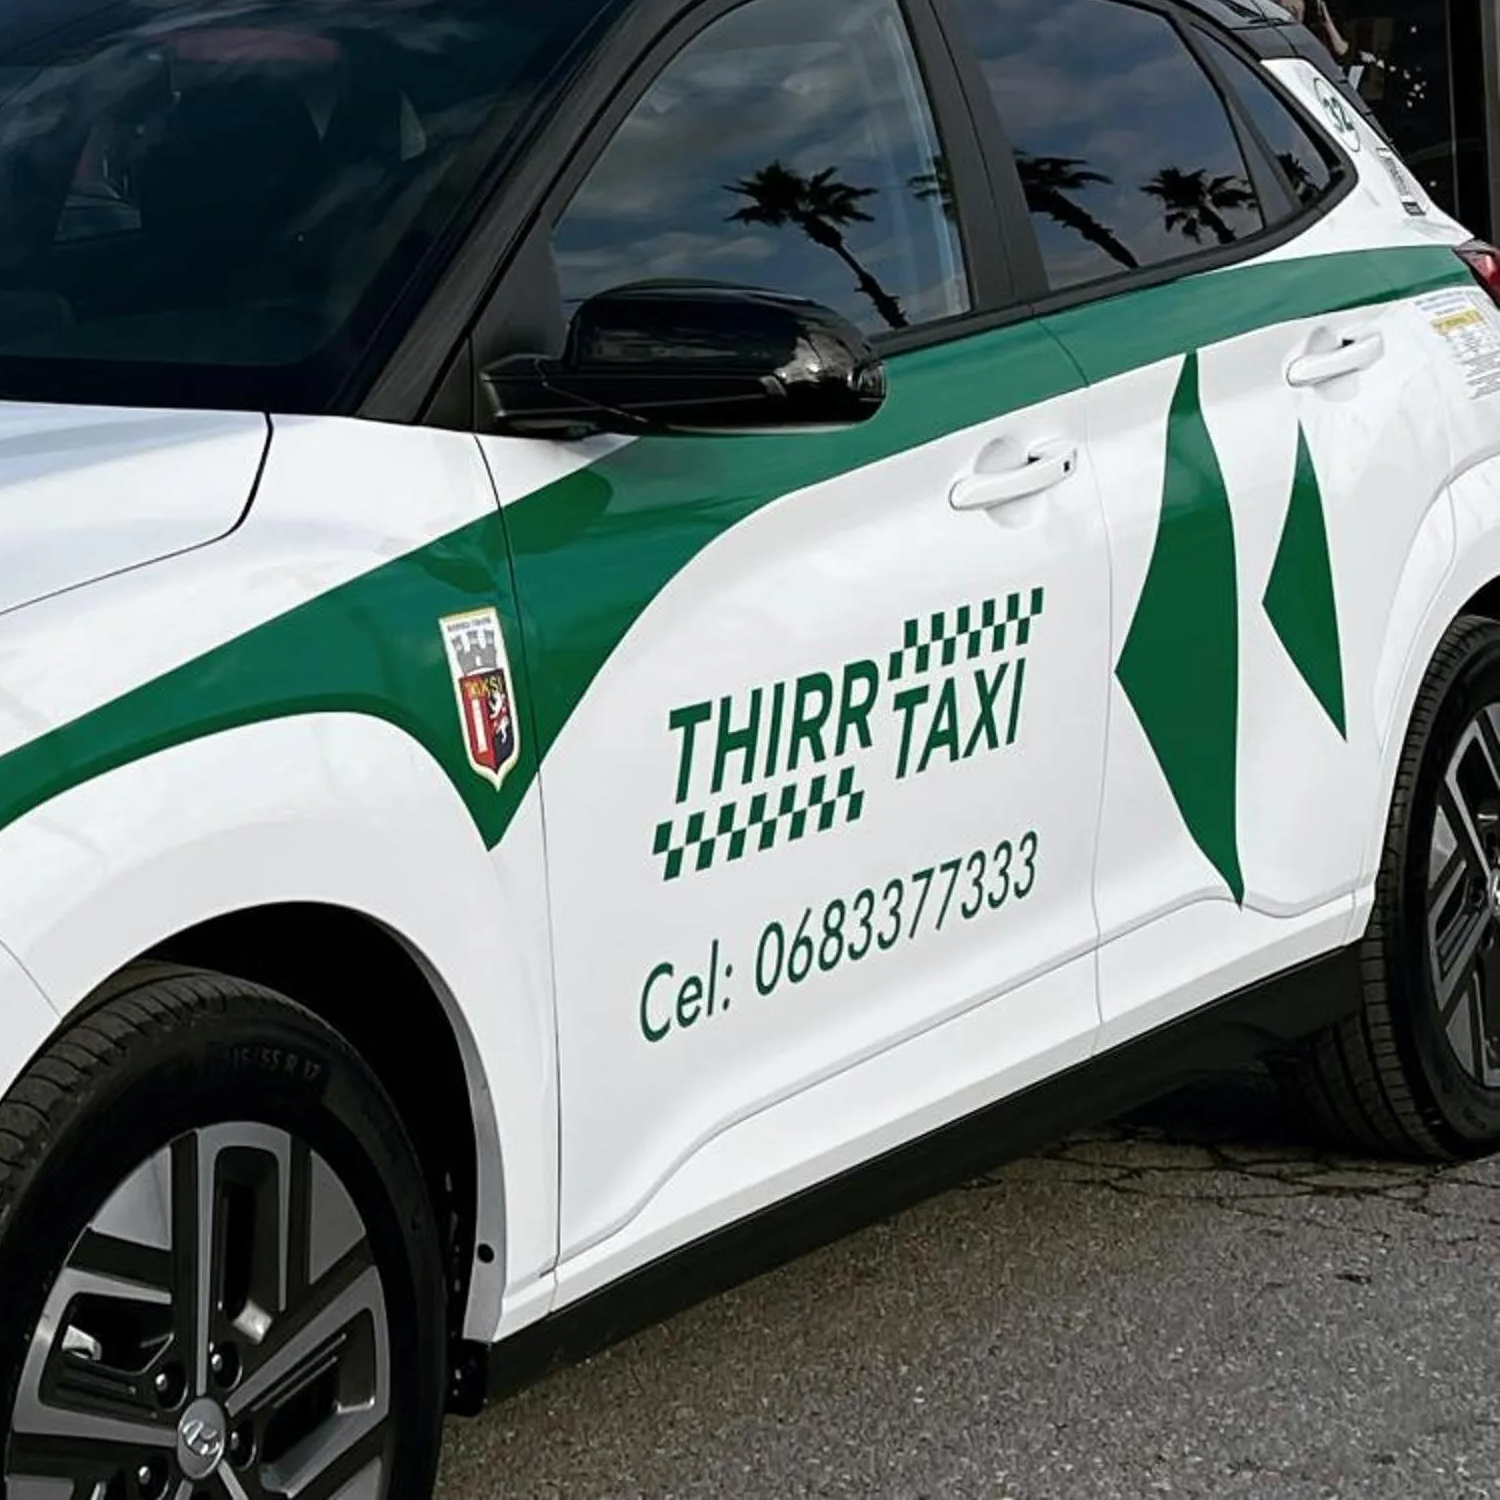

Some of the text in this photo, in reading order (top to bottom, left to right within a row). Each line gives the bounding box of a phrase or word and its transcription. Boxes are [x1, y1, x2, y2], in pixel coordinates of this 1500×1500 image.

[667, 657, 1026, 804] THIRR TAXI
[639, 830, 1039, 1042] Cel: 0683377333
